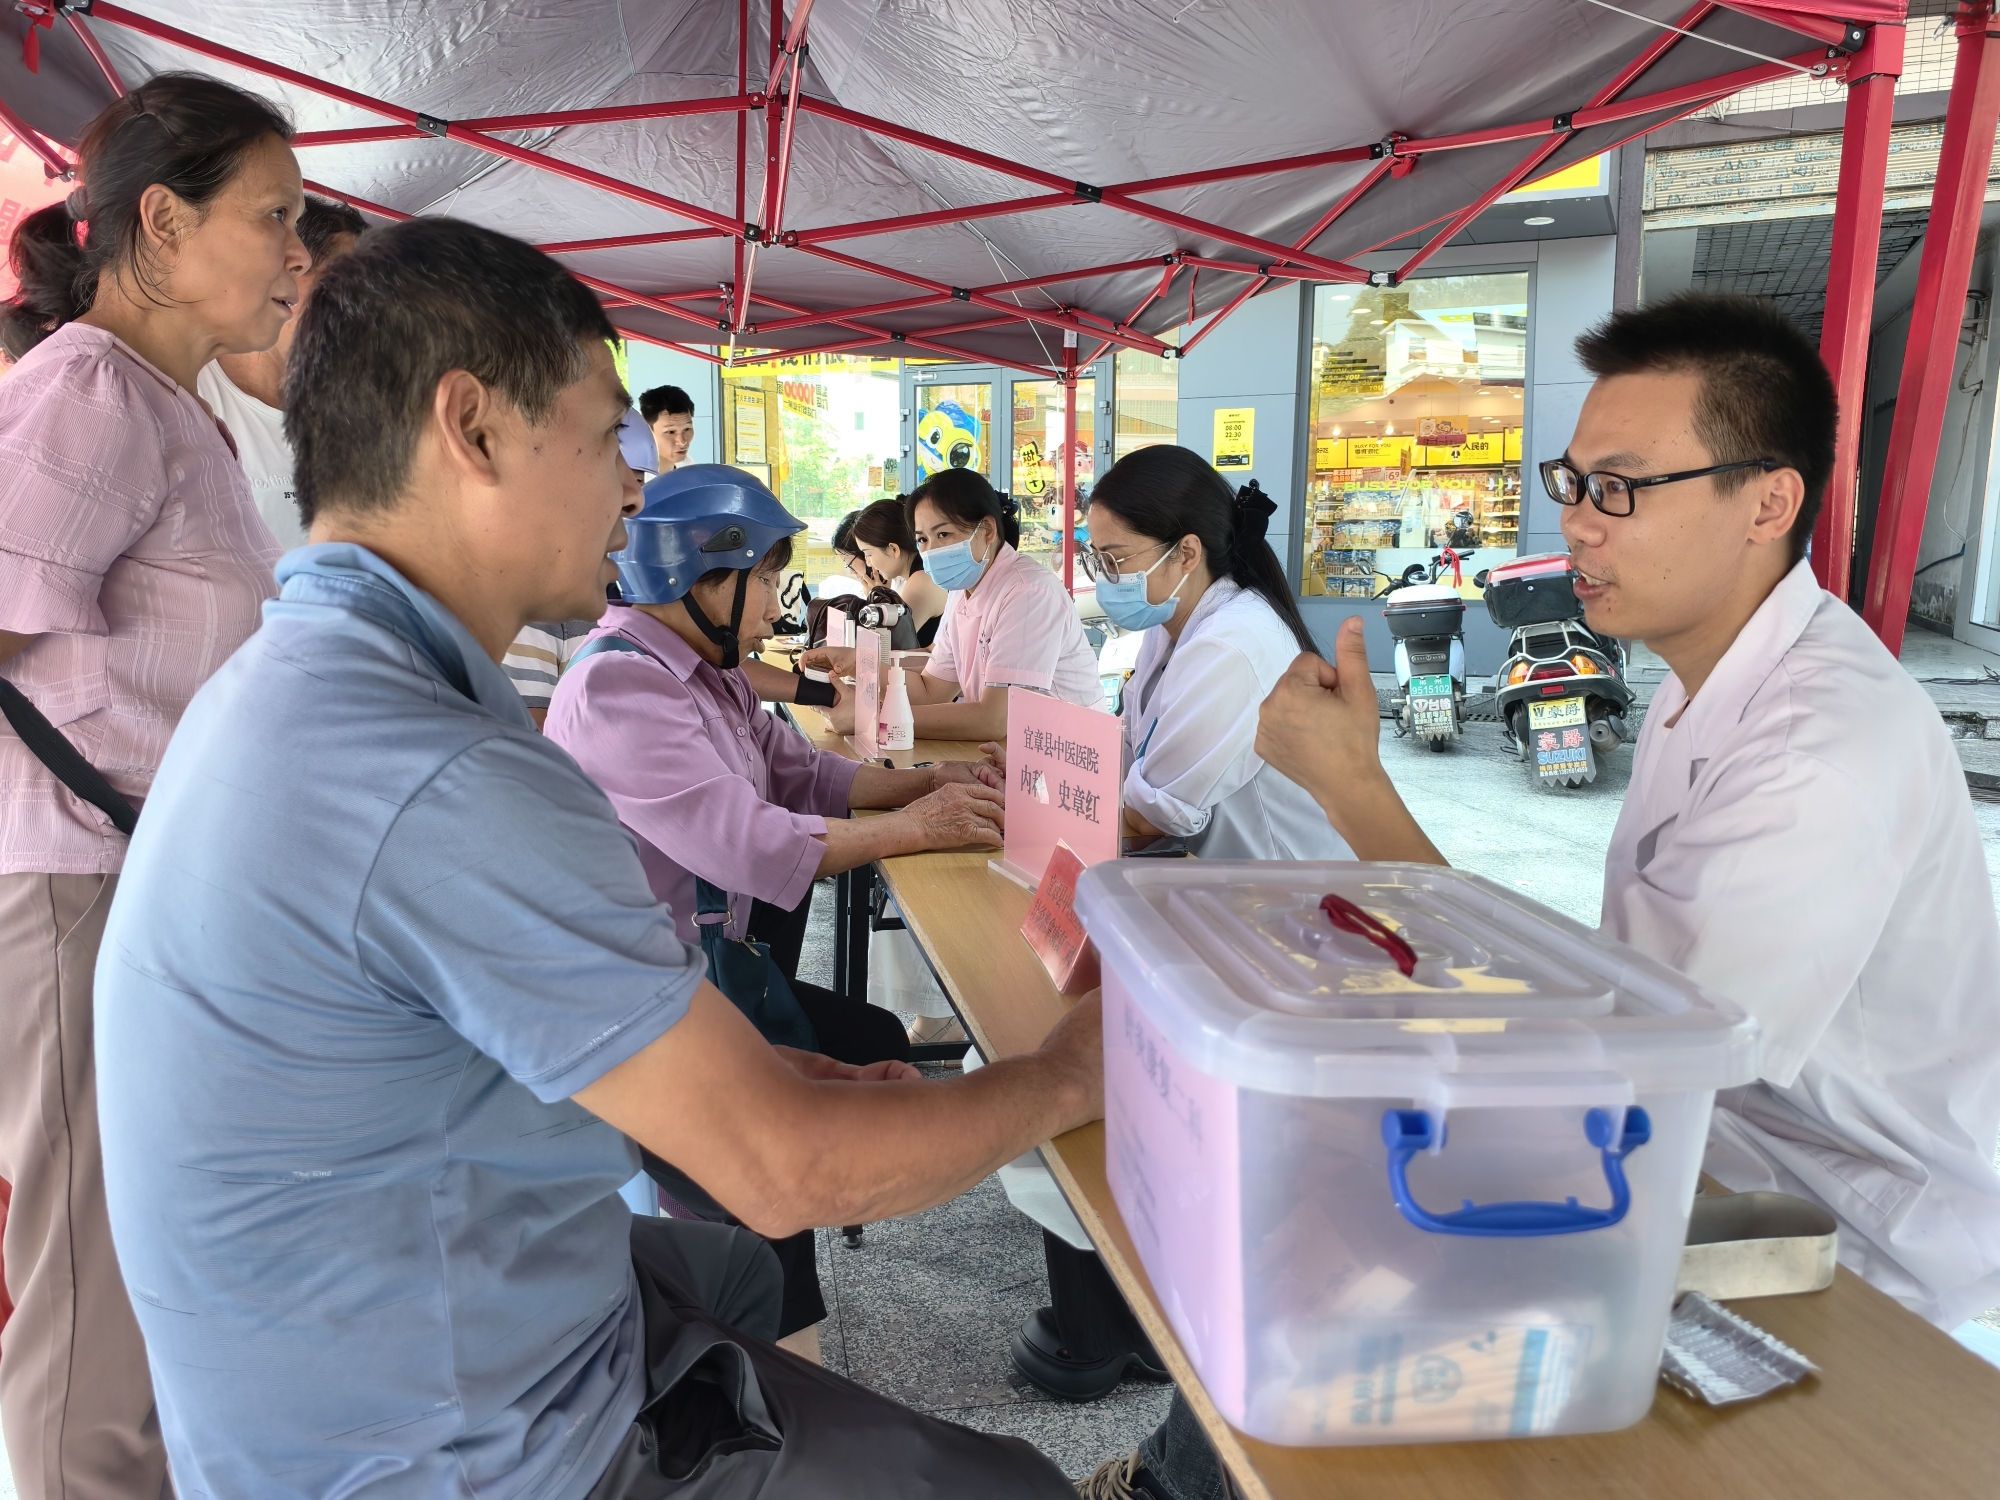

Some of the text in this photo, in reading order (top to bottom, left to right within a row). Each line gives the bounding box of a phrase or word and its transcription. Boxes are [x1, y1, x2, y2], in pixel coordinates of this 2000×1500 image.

[1462, 442, 1489, 451] 人民的
[1412, 685, 1450, 695] 9515102
[1023, 725, 1099, 775] 宜章县中医医院
[1536, 728, 1585, 752] 豪爵
[1537, 747, 1587, 765] SUZUKI
[1057, 779, 1101, 825] 史章红
